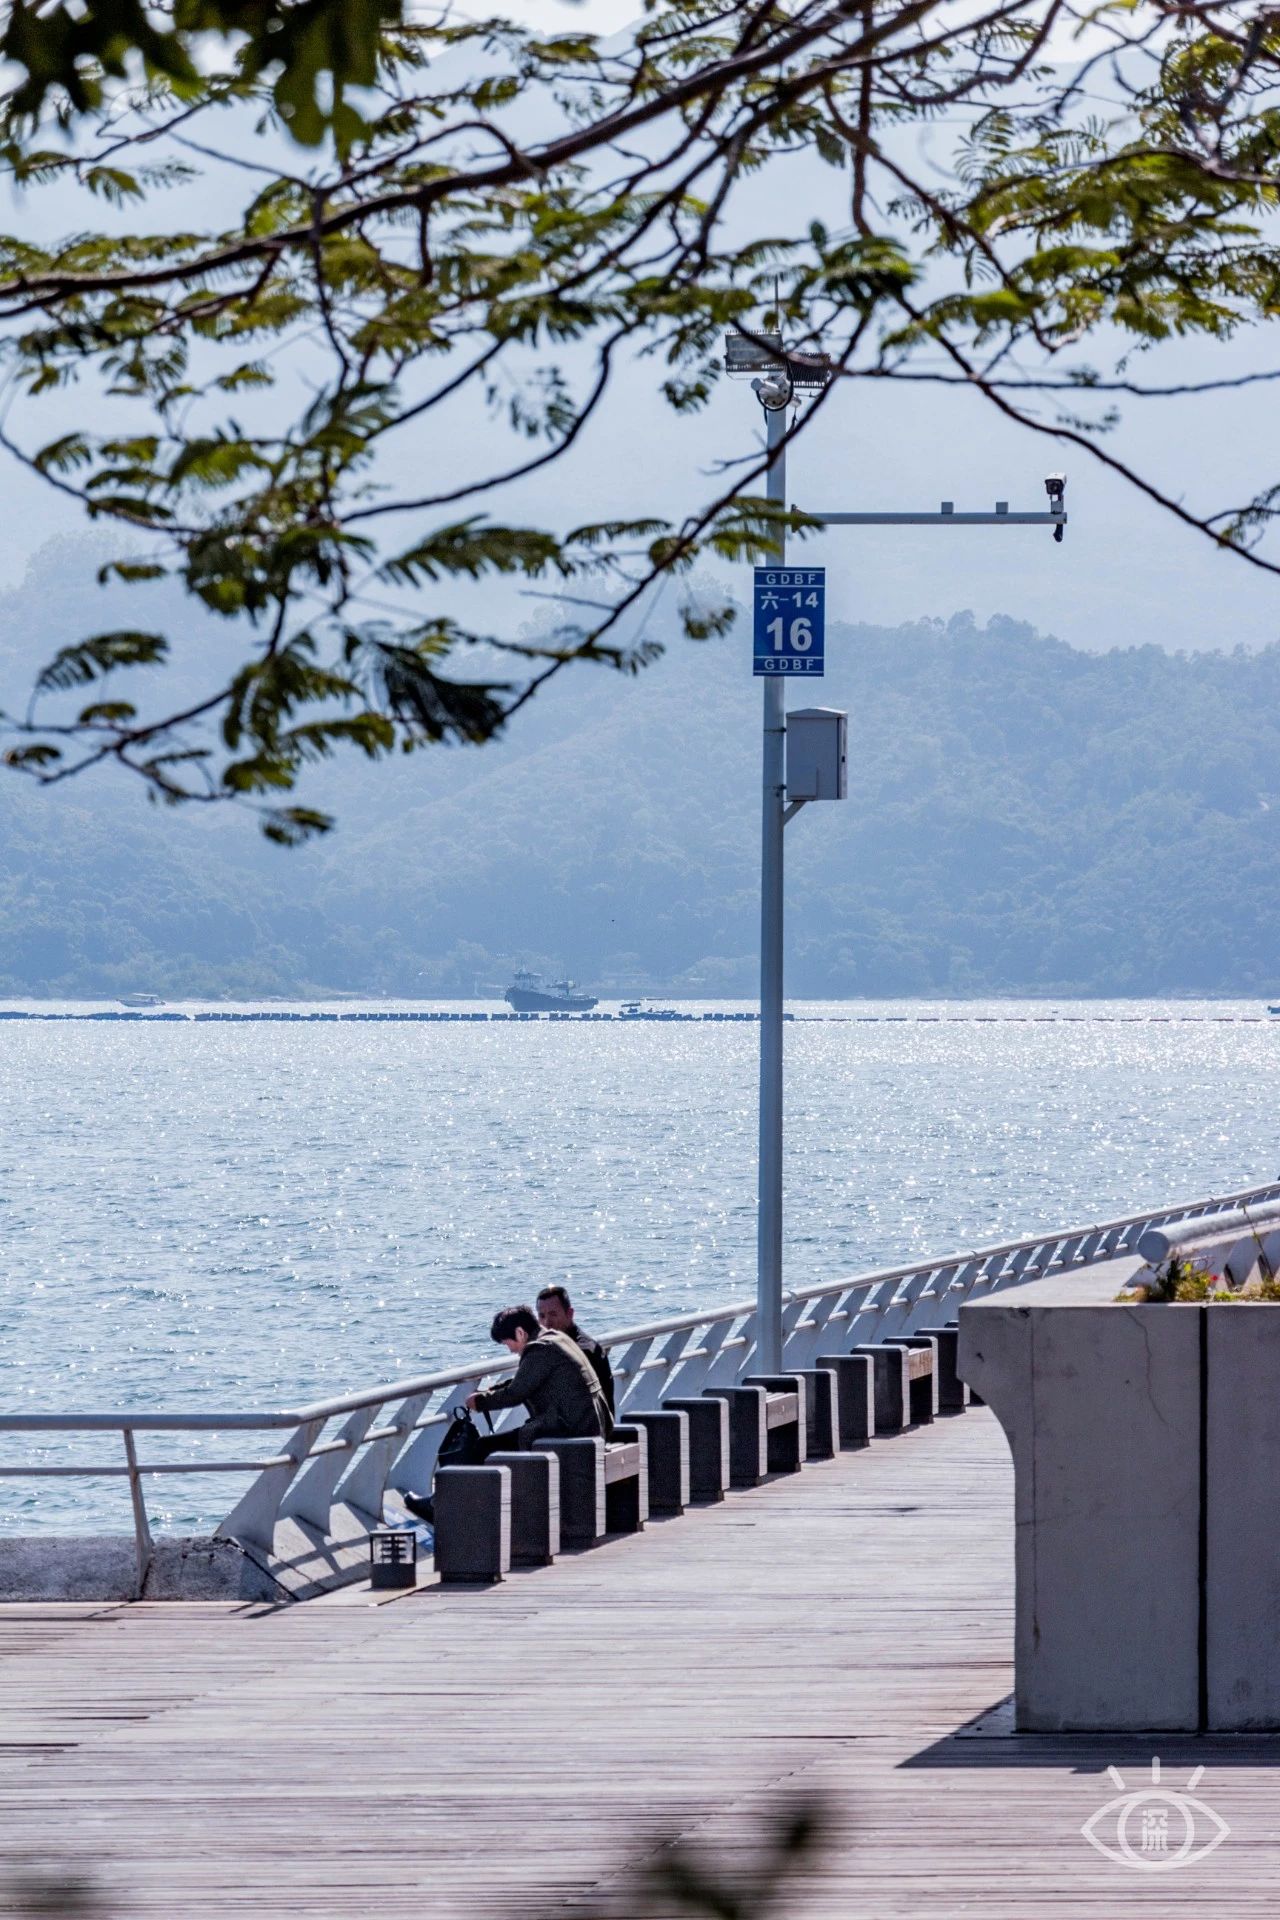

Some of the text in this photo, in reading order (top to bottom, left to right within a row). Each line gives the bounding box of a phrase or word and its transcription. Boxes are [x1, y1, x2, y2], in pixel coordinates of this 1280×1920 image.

[766, 573, 816, 585] GDBF
[760, 591, 819, 610] 六-14
[766, 617, 812, 651] 16
[764, 659, 814, 670] GDBF
